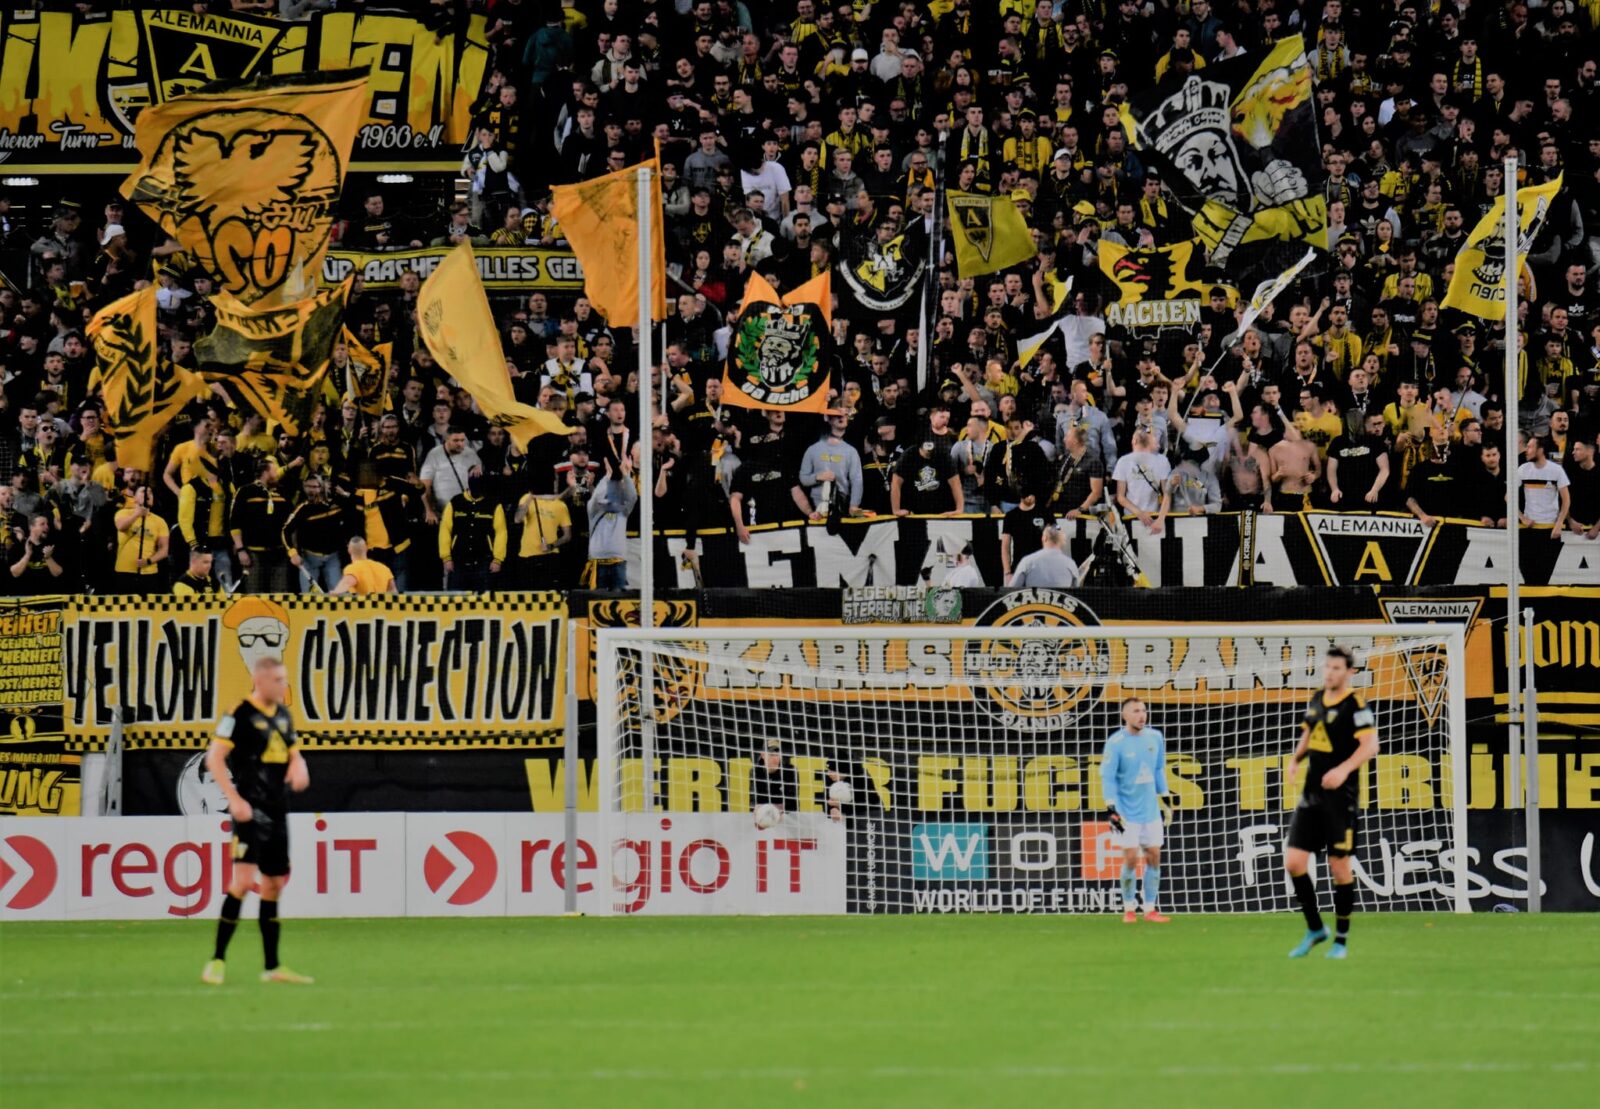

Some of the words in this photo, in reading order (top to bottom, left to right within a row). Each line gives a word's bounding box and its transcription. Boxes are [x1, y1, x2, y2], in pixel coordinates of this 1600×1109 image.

[150, 9, 265, 44] ALEMANNIA
[179, 43, 217, 79] A
[51, 122, 112, 151] Turn-
[360, 125, 411, 148] 1900
[323, 256, 355, 281] ÜR
[365, 256, 446, 281] AACHE
[1107, 301, 1200, 326] AACHEN
[1317, 517, 1425, 536] ALEMANNIA
[1354, 541, 1393, 581] A
[843, 601, 901, 617] STERBEN
[1002, 590, 1079, 612] KARLS
[1392, 604, 1471, 616] ALEMANNIA
[0, 611, 60, 636] EIHEIT
[65, 617, 219, 723] YELLOW
[301, 617, 561, 723] CONNECTION
[702, 638, 952, 688] KARLS
[82, 820, 290, 917] regi
[520, 818, 731, 913] regio
[1237, 824, 1548, 898] FNESS
[914, 888, 1002, 912] WORLD
[1011, 888, 1044, 912] OF
